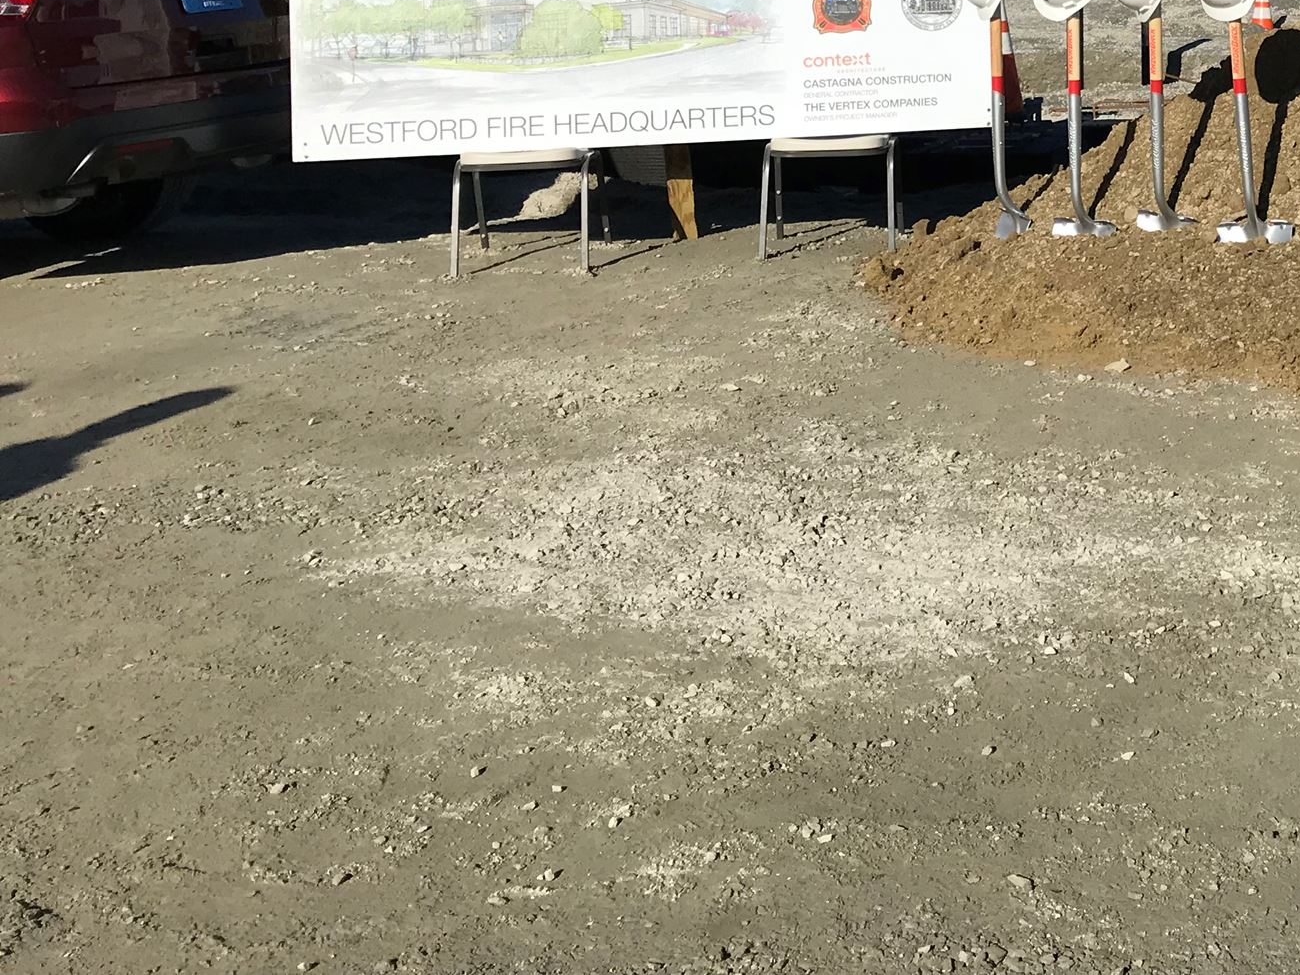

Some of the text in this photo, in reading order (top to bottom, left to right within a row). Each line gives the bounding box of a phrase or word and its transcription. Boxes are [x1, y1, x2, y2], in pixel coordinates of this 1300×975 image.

[803, 52, 872, 68] context
[803, 73, 952, 89] CASTAGNA CONSTRUCTION
[803, 88, 879, 99] GENERAL CONTRACTOR
[804, 96, 938, 112] THE VERTEX COMPANIES
[865, 111, 898, 119] MANAGER
[320, 104, 775, 145] WESTFORD FIRE HEADQUARTERS
